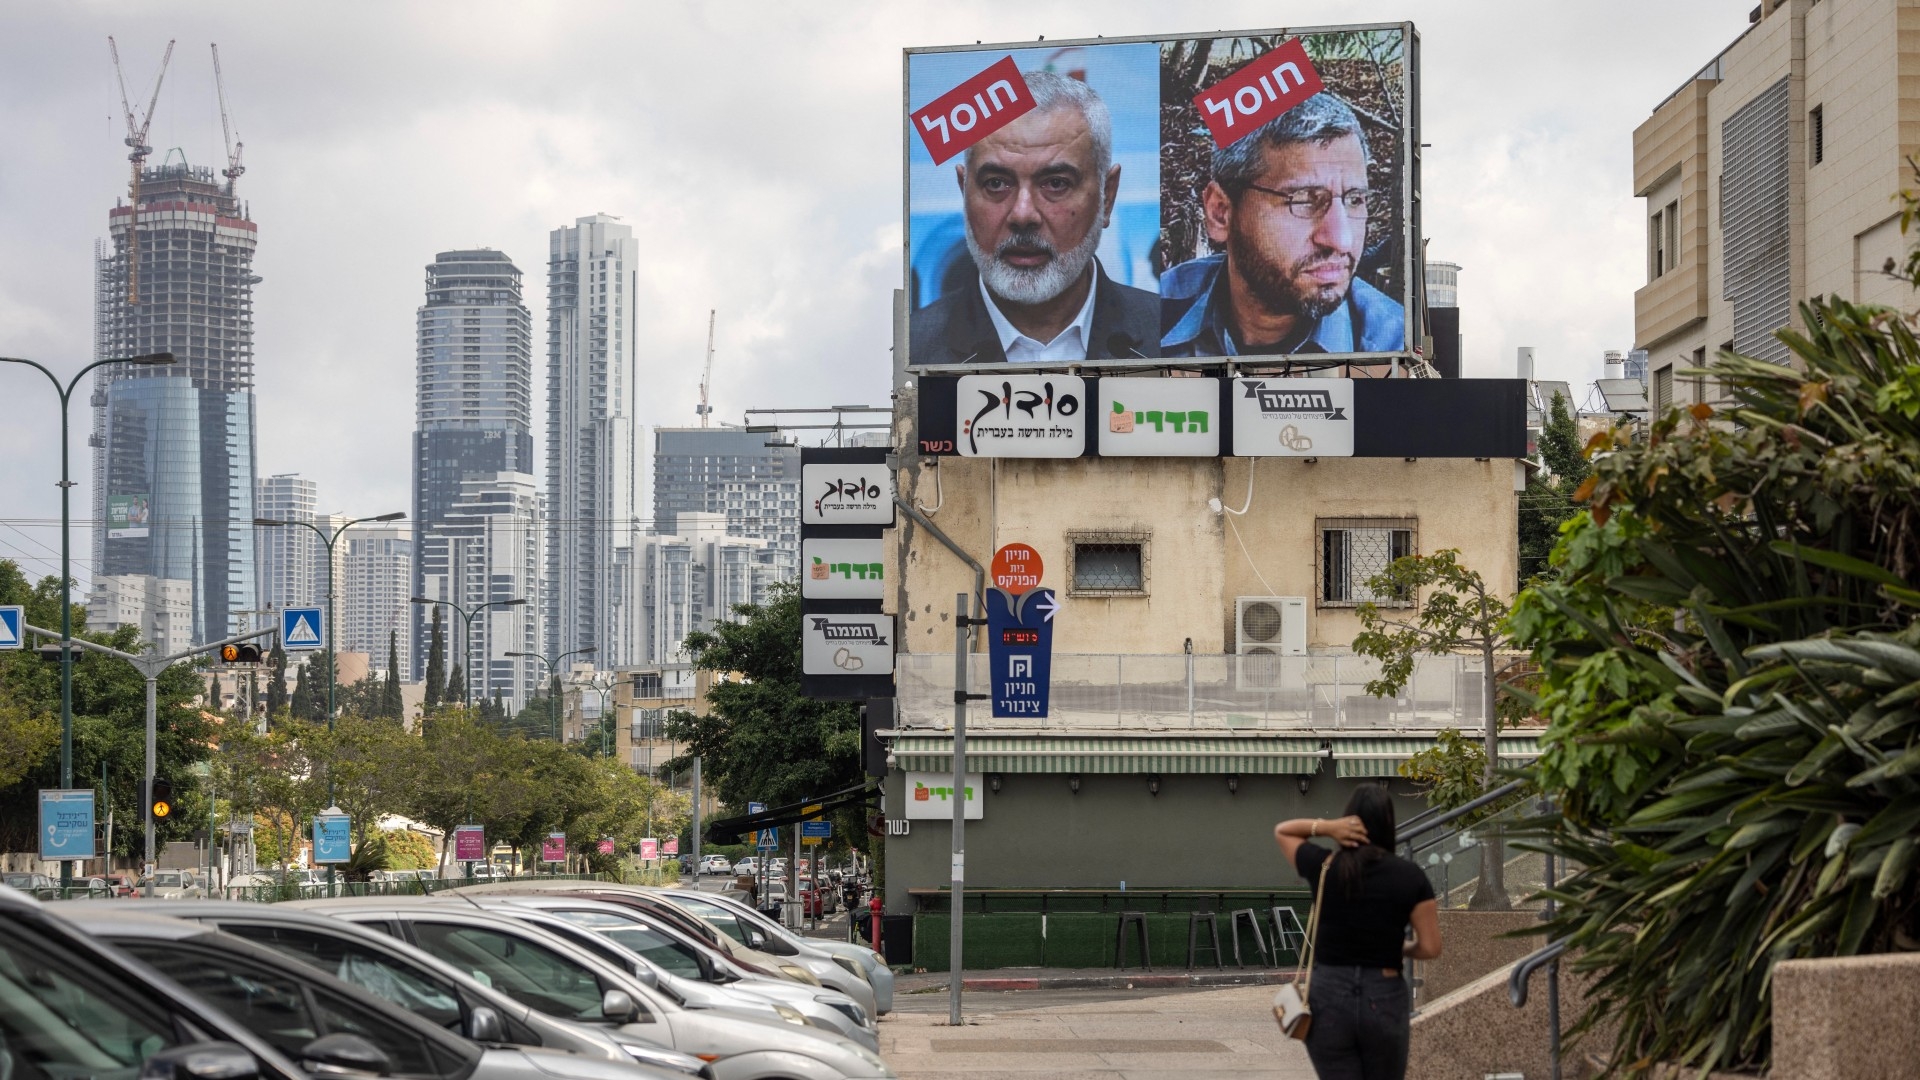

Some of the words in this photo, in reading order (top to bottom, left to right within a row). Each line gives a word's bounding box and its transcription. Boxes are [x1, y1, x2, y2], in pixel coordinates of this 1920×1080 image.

[1204, 61, 1305, 128] חוסל
[921, 79, 1018, 144] חוסל
[1263, 394, 1327, 408] חממה
[1135, 410, 1209, 433] הדרי
[484, 431, 501, 439] IBM
[977, 427, 1014, 439] בעברית
[1018, 427, 1045, 438] חדשה
[1049, 425, 1073, 438] מילה
[920, 440, 953, 452] כשר
[824, 503, 844, 511] בעברית
[863, 502, 876, 510] מילה
[1005, 550, 1030, 563] חניון
[1010, 564, 1025, 573] בית
[998, 575, 1037, 588] הפניקס
[827, 626, 874, 637] חממה
[1004, 682, 1035, 697] חניון
[1000, 701, 1040, 713] ציבורי
[885, 820, 910, 835] כשר
